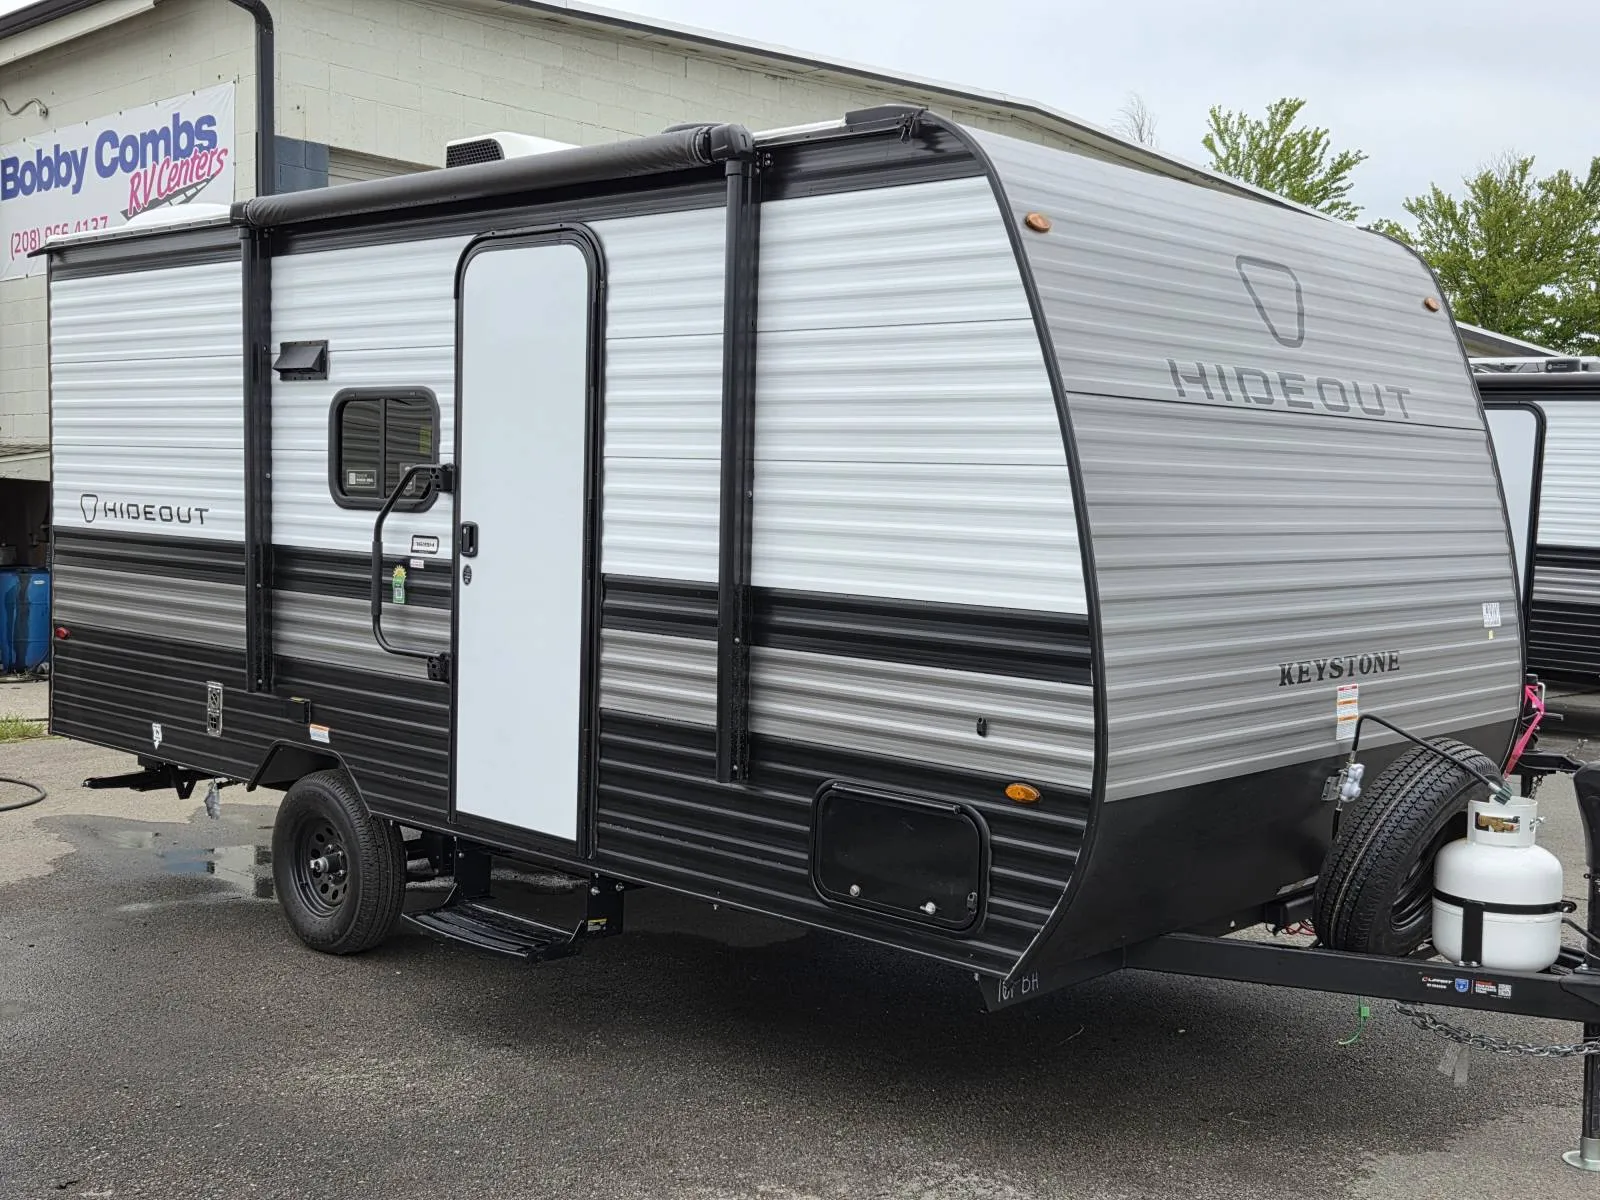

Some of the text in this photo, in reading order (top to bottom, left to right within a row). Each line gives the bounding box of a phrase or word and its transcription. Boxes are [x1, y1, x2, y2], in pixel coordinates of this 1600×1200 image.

[0, 112, 218, 201] Bobby Combs
[127, 147, 229, 217] RV Centers
[11, 227, 41, 261] (208)
[1166, 358, 1412, 419] HIDEOUT
[103, 502, 209, 525] HIDEOUT
[1278, 650, 1401, 687] KEYSTONE
